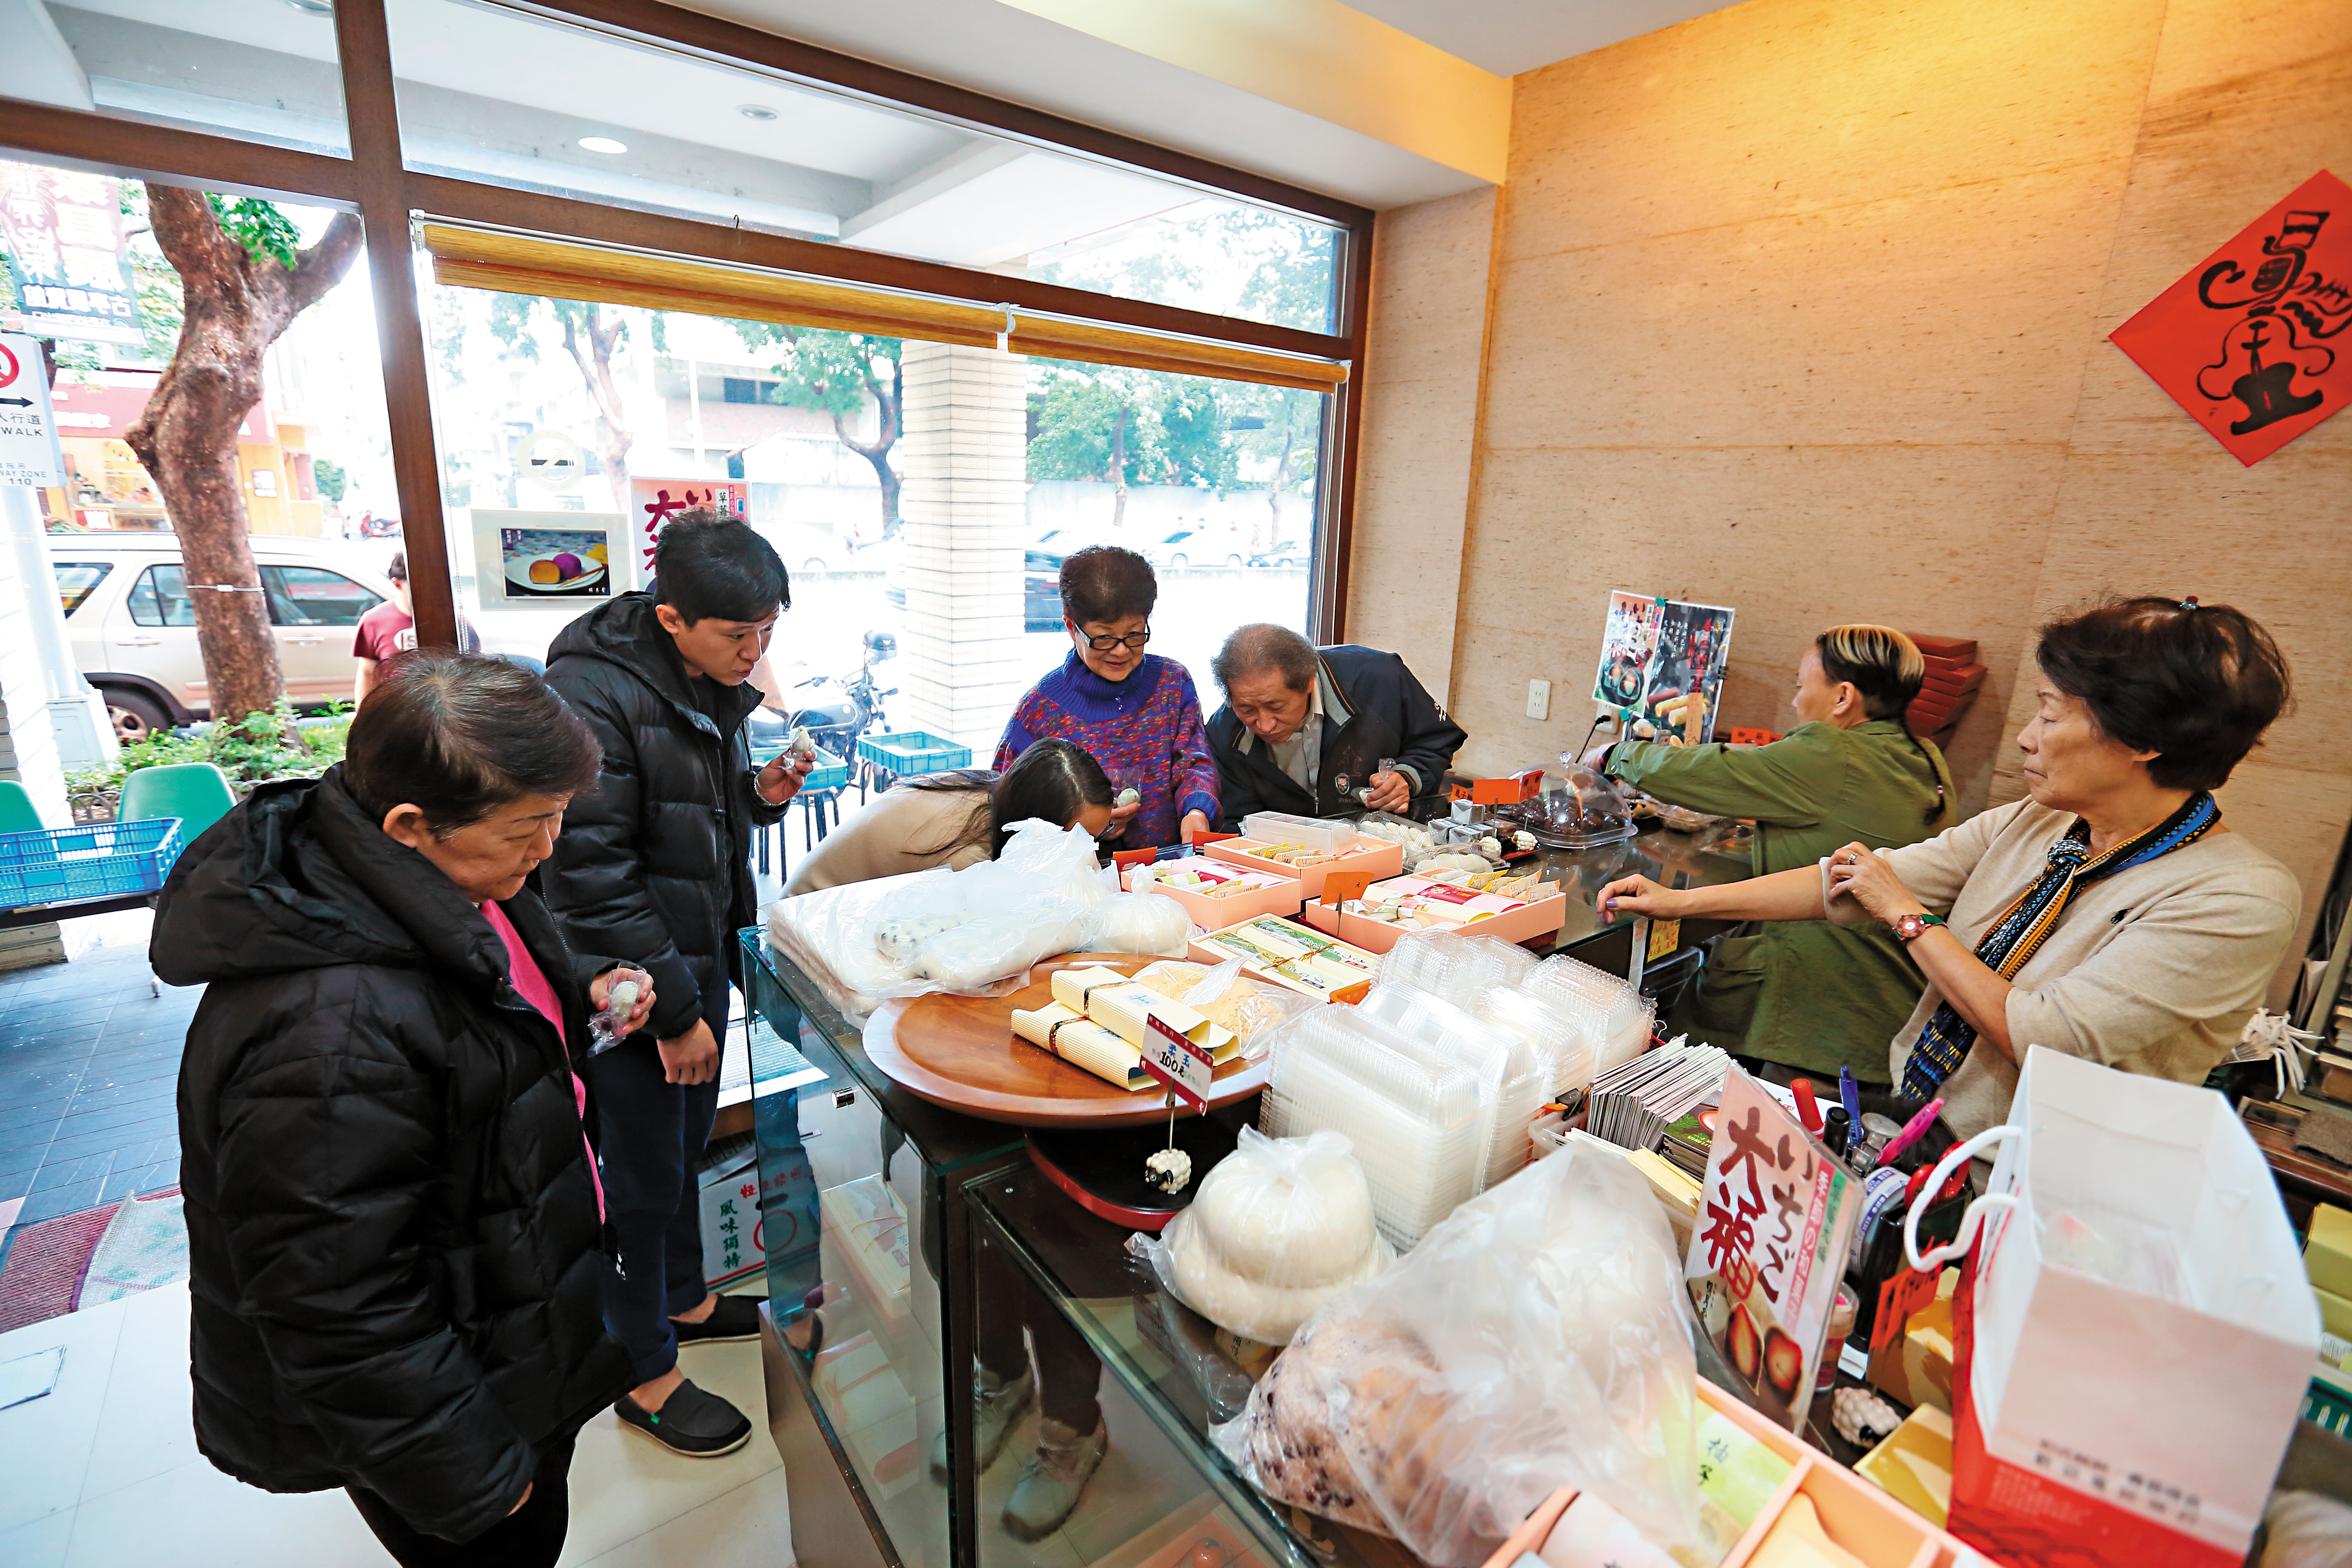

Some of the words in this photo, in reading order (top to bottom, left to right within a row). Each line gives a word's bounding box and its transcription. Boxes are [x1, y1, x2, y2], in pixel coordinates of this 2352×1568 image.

[1700, 1106, 1776, 1300] 大福
[1757, 1134, 1813, 1303] いちご
